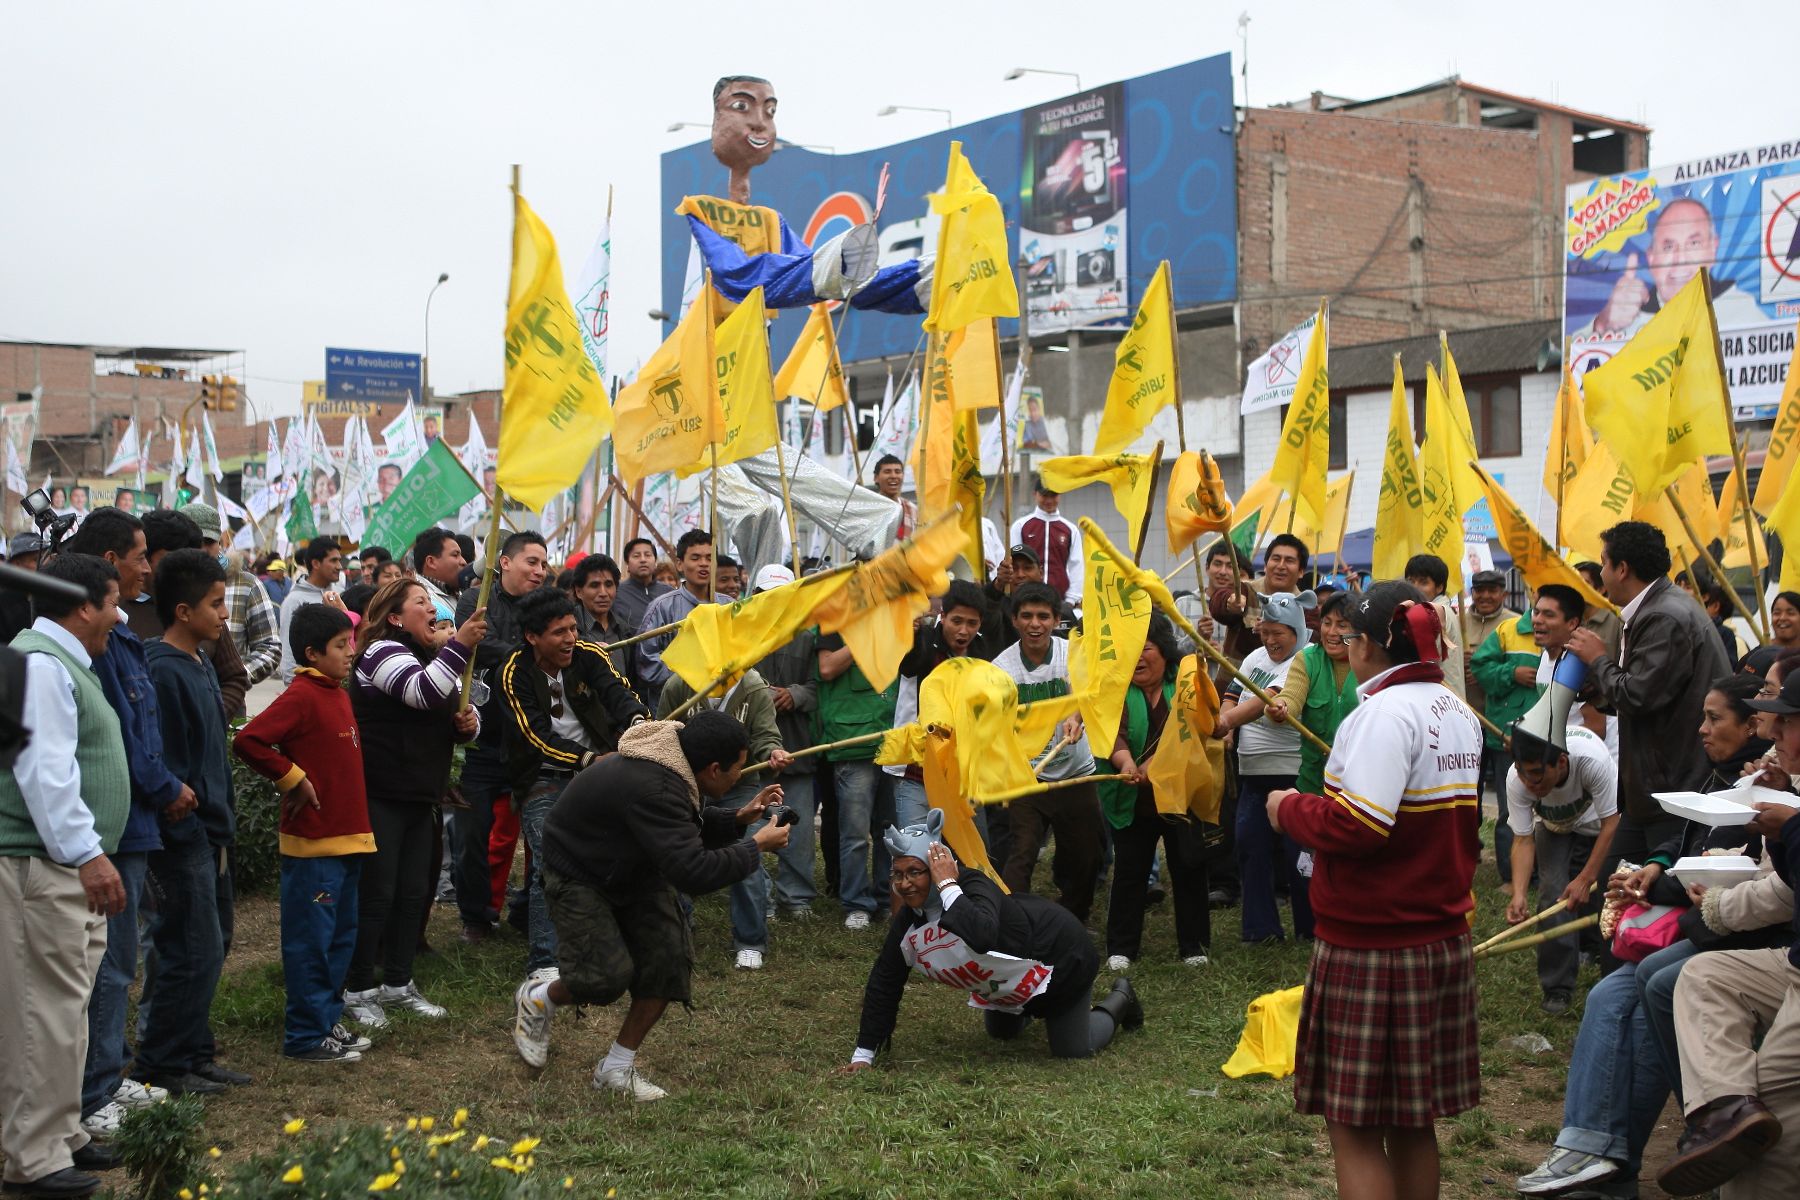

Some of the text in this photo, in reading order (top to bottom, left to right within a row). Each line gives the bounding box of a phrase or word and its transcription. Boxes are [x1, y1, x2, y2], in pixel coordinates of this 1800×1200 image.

[1674, 140, 1800, 182] ALIANZA PARA
[1570, 185, 1655, 255] GANADOR
[1573, 177, 1636, 226] VOTA A
[357, 355, 405, 369] Revolución
[1748, 332, 1795, 355] SUCIA
[1739, 362, 1791, 386] AZCUE
[548, 383, 585, 432] PERU
[1387, 425, 1423, 510] MOZO
[1425, 521, 1449, 553] PERU
